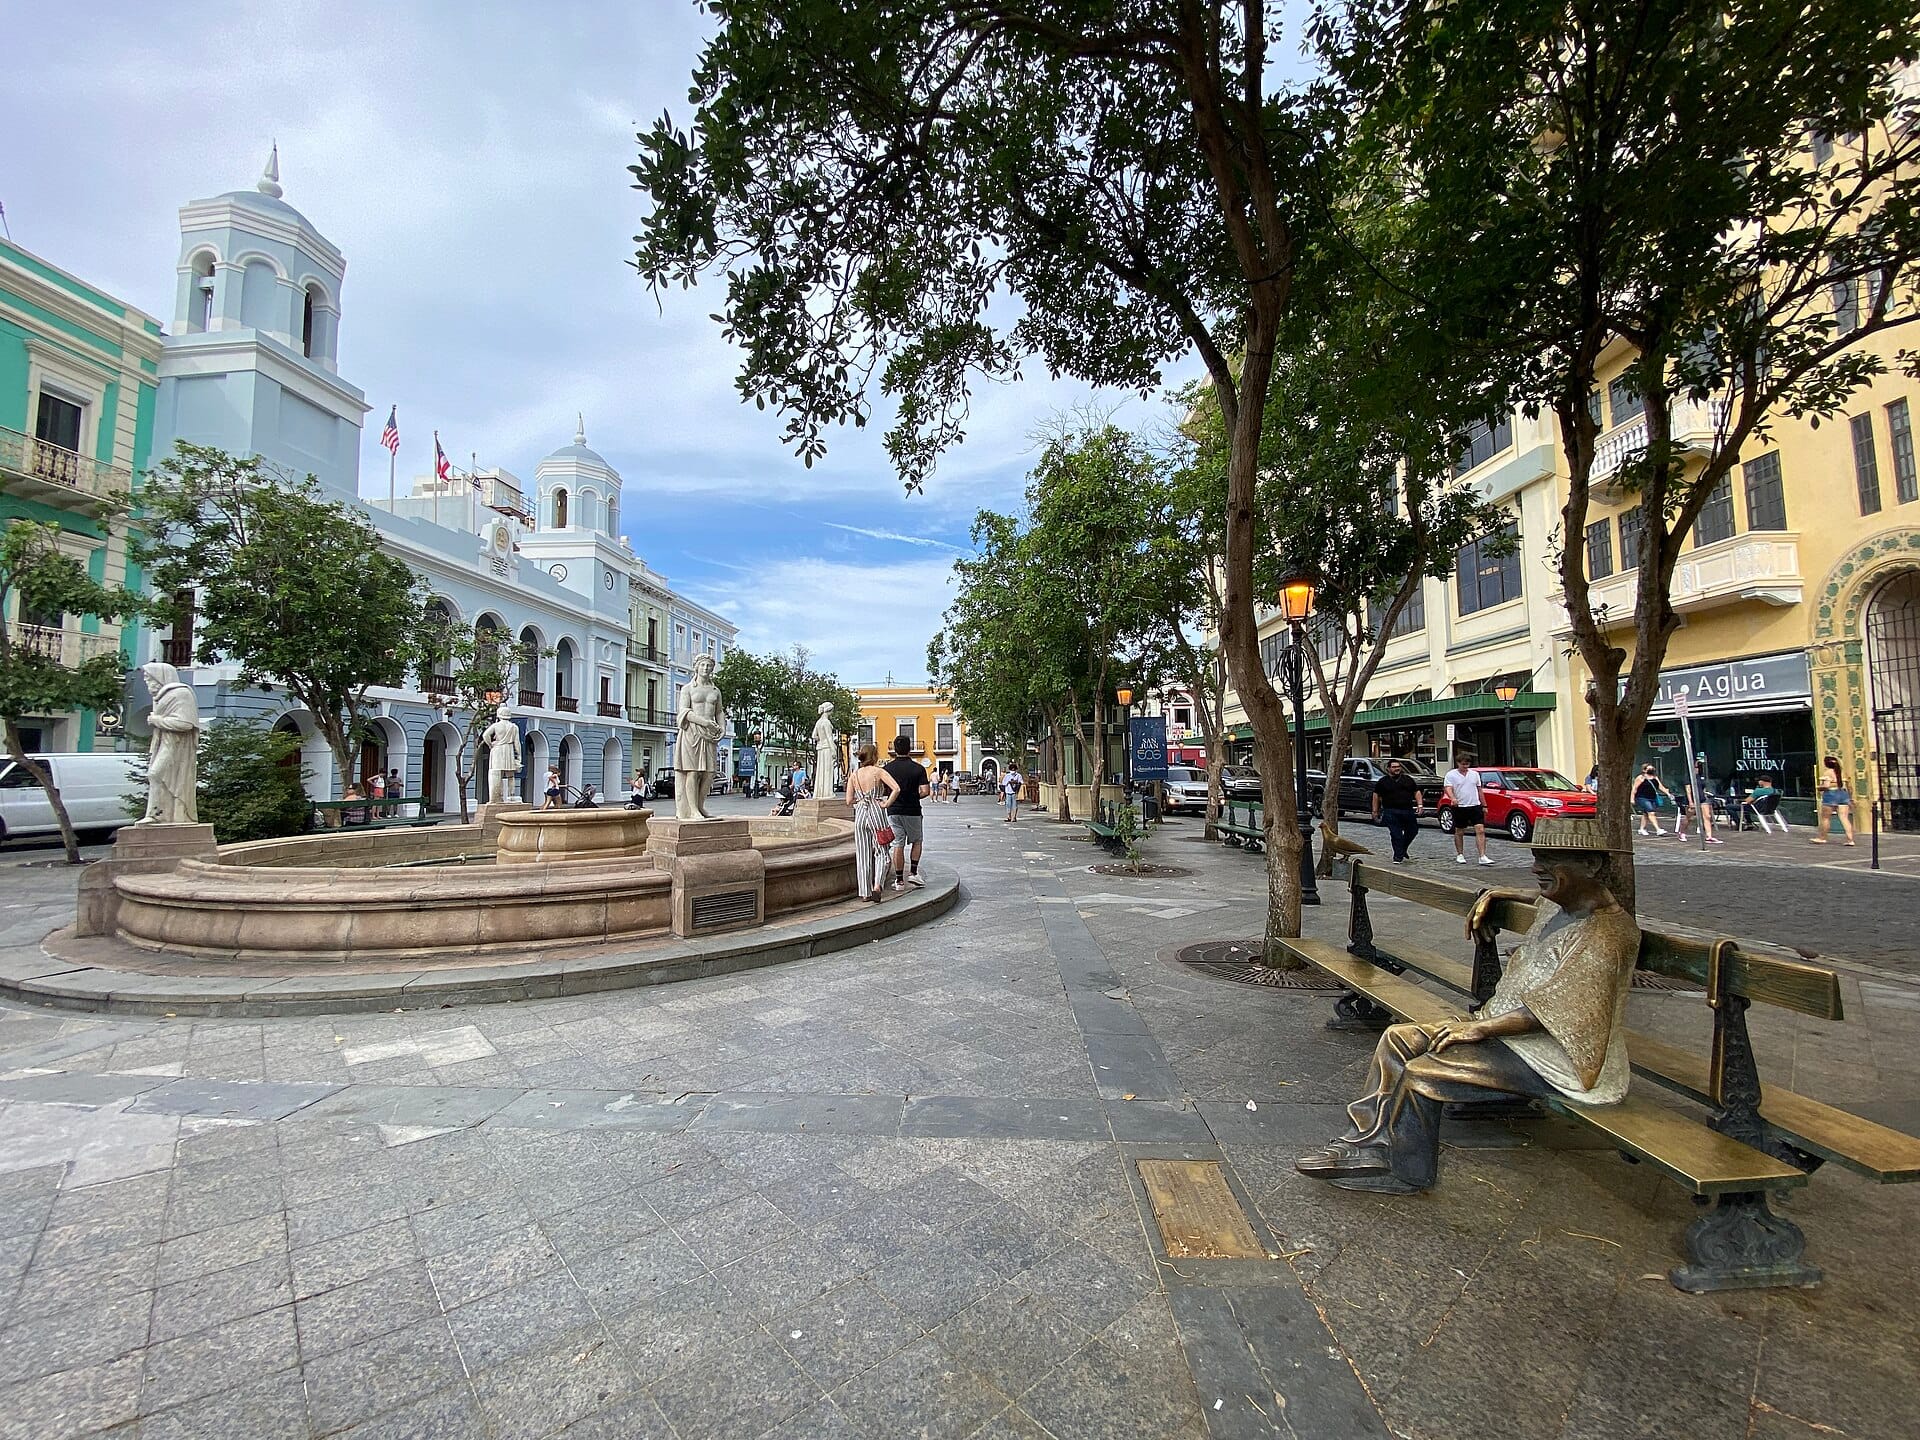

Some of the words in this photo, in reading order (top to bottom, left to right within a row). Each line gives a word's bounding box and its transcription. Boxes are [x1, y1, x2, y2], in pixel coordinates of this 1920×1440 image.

[1697, 672, 1765, 697] Agua
[1742, 736, 1768, 748] FREE
[1742, 748, 1768, 759] BEER
[1736, 759, 1786, 771] SATURDAY
